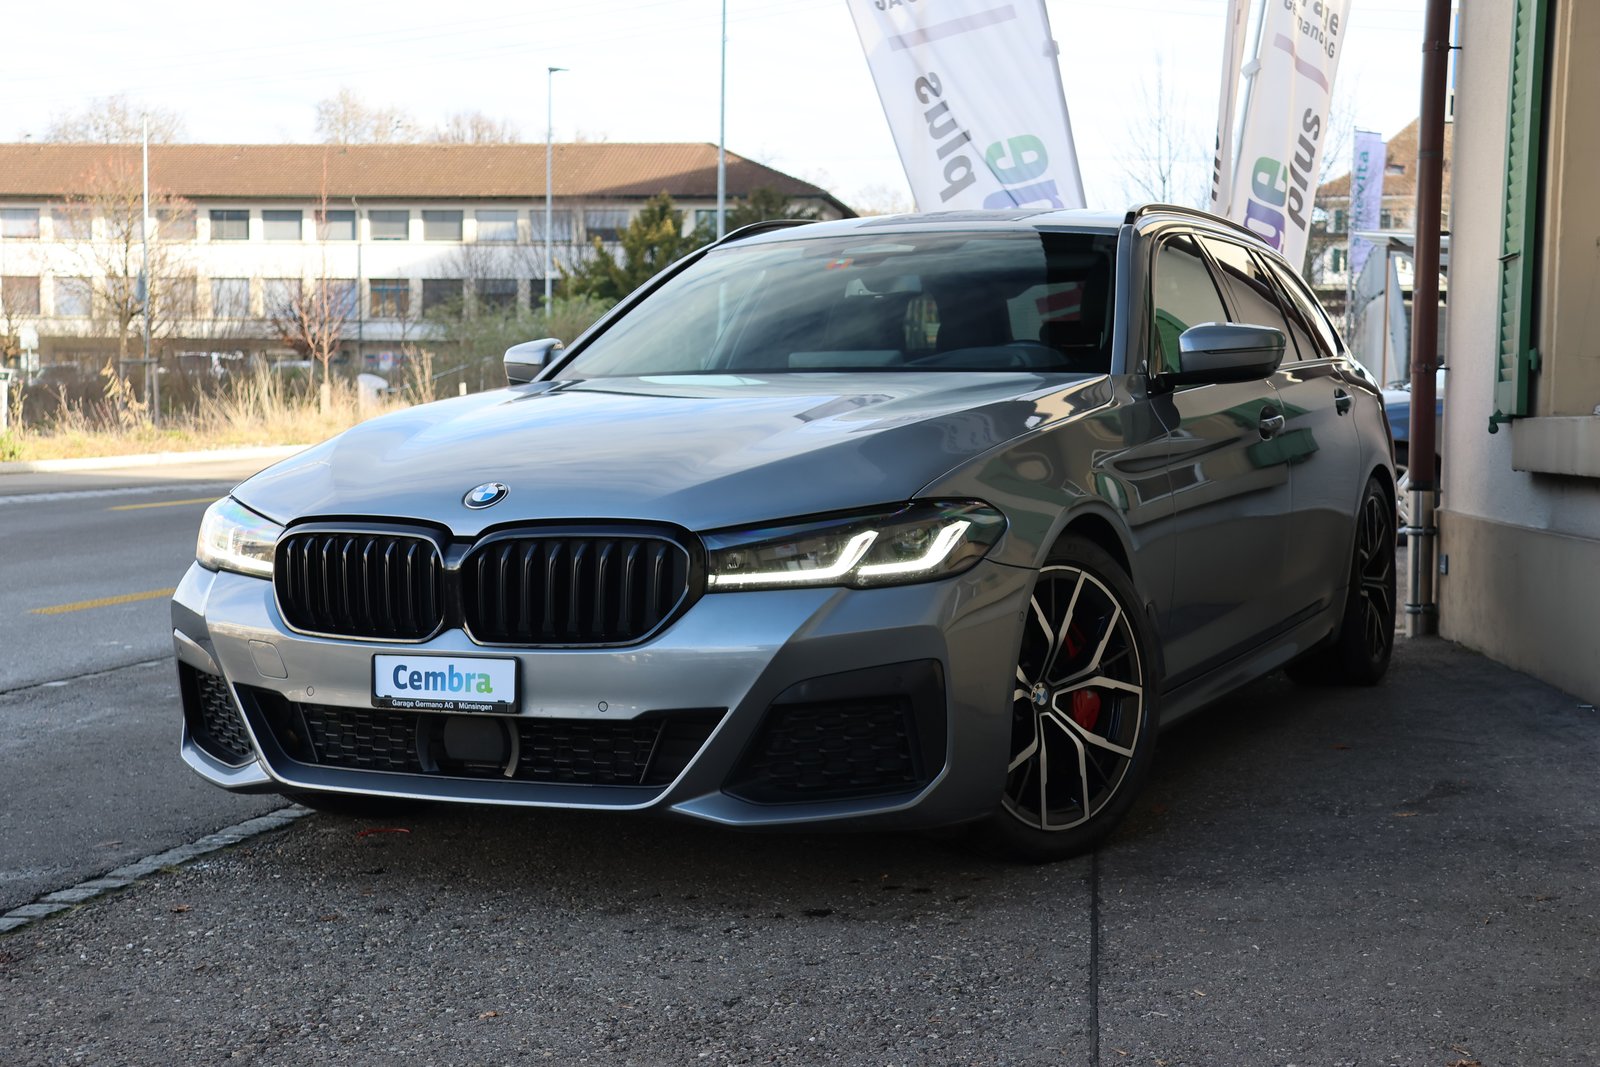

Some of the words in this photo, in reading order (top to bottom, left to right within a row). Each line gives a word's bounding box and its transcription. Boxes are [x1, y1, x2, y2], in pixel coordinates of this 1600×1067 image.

[1288, 107, 1321, 232] plus
[393, 664, 493, 694] Cembra
[392, 699, 414, 708] Garage
[415, 700, 443, 709] Germano
[443, 701, 454, 709] AG
[458, 702, 493, 711] Münsingen
